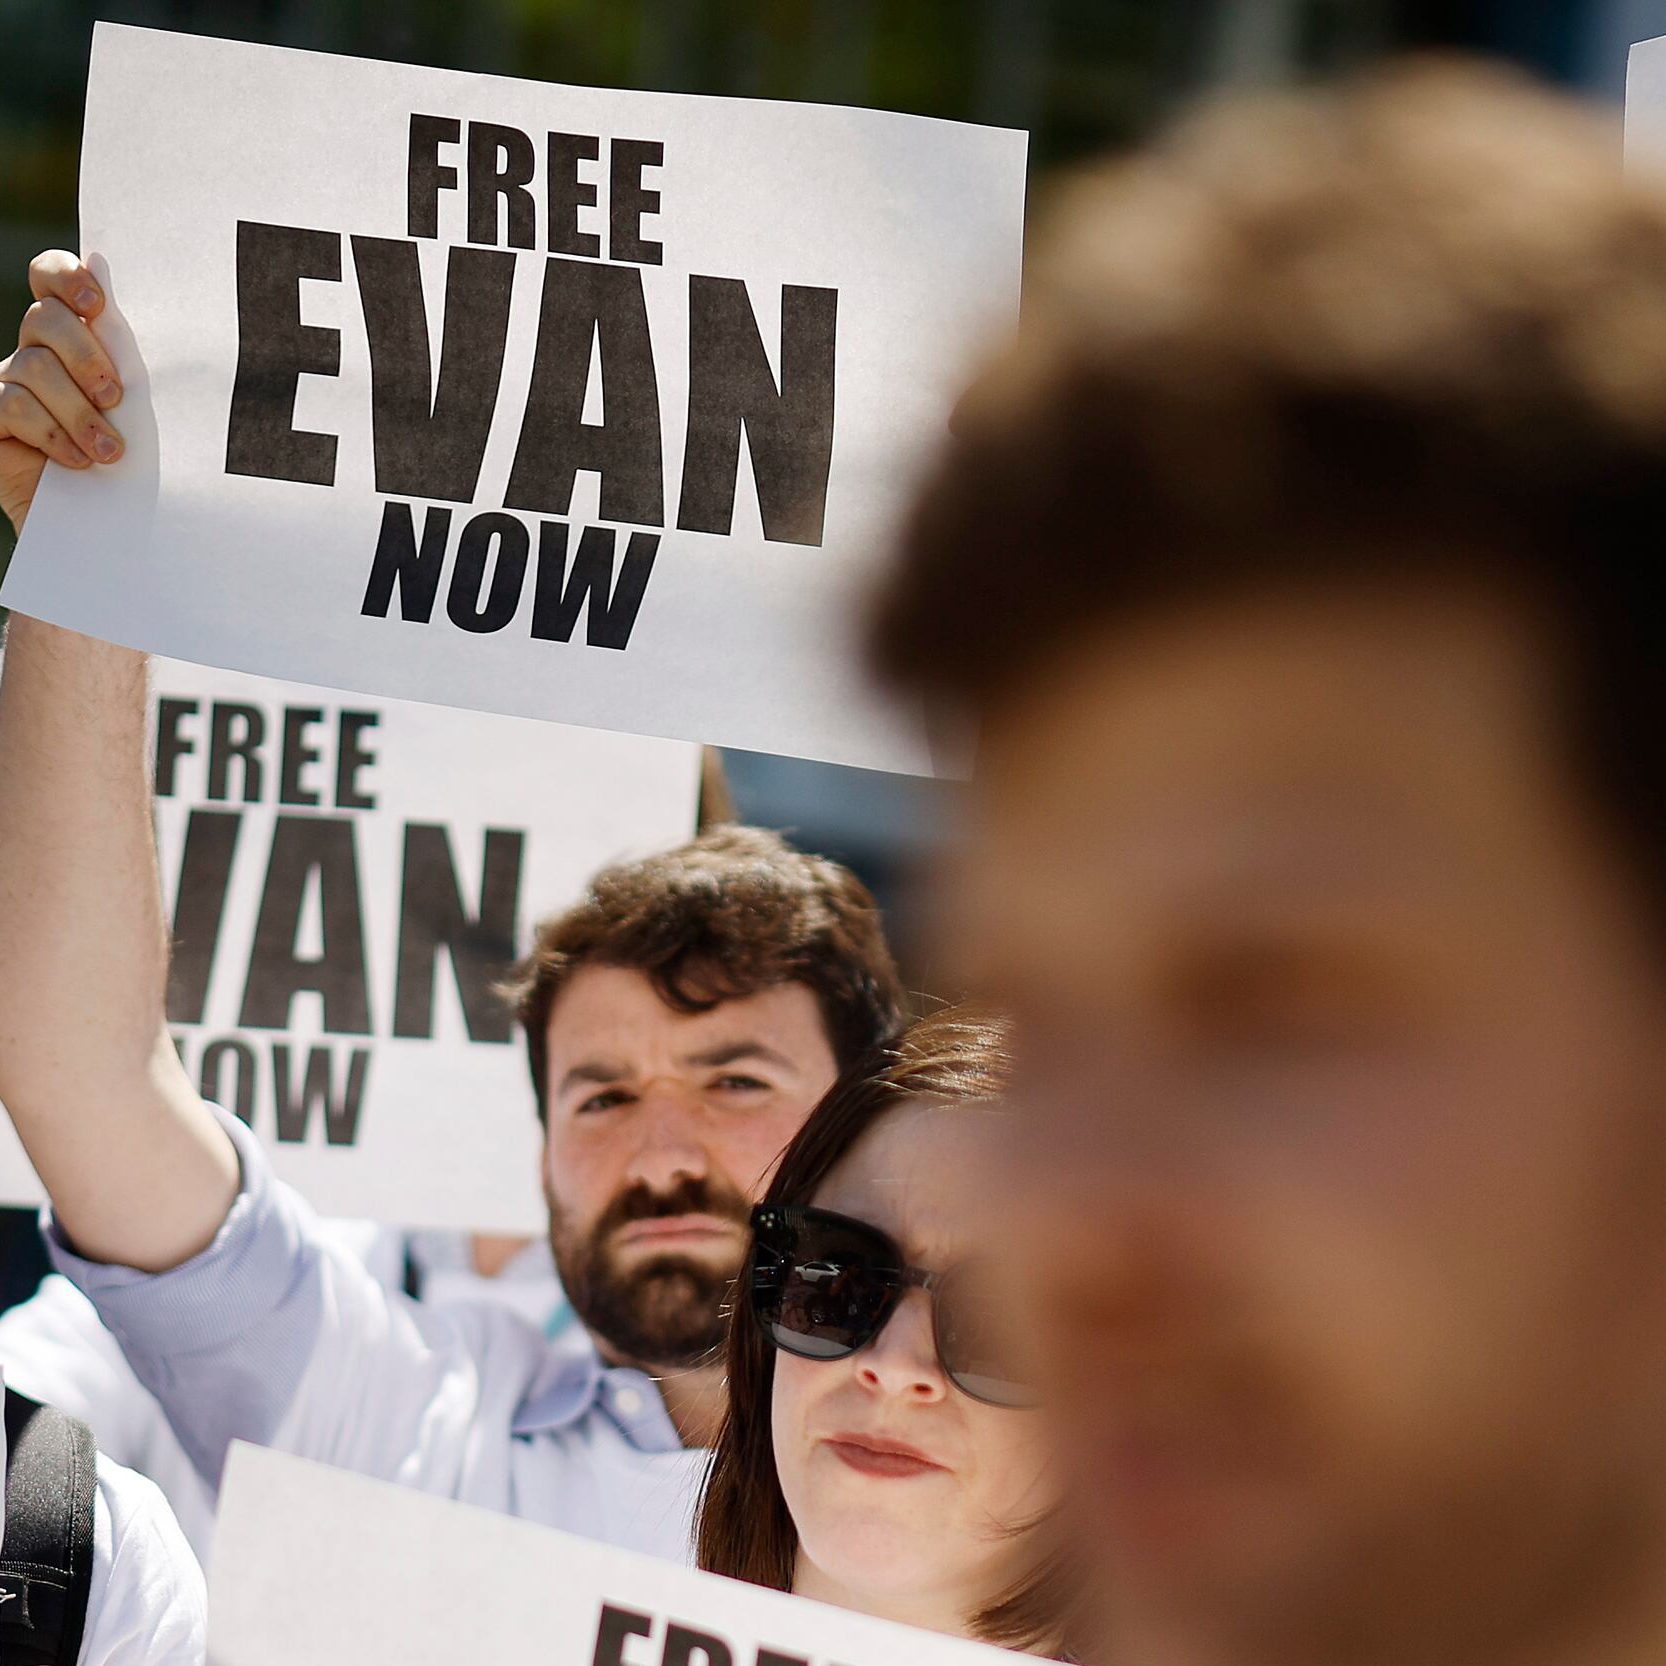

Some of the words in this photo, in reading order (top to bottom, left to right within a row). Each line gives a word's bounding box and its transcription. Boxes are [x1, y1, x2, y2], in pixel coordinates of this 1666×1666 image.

[407, 112, 665, 267] FREE
[226, 220, 839, 548] EVAN
[360, 502, 662, 651] NOW
[155, 697, 381, 810] FREE
[165, 809, 527, 1045] VAN
[173, 1037, 372, 1147] OW
